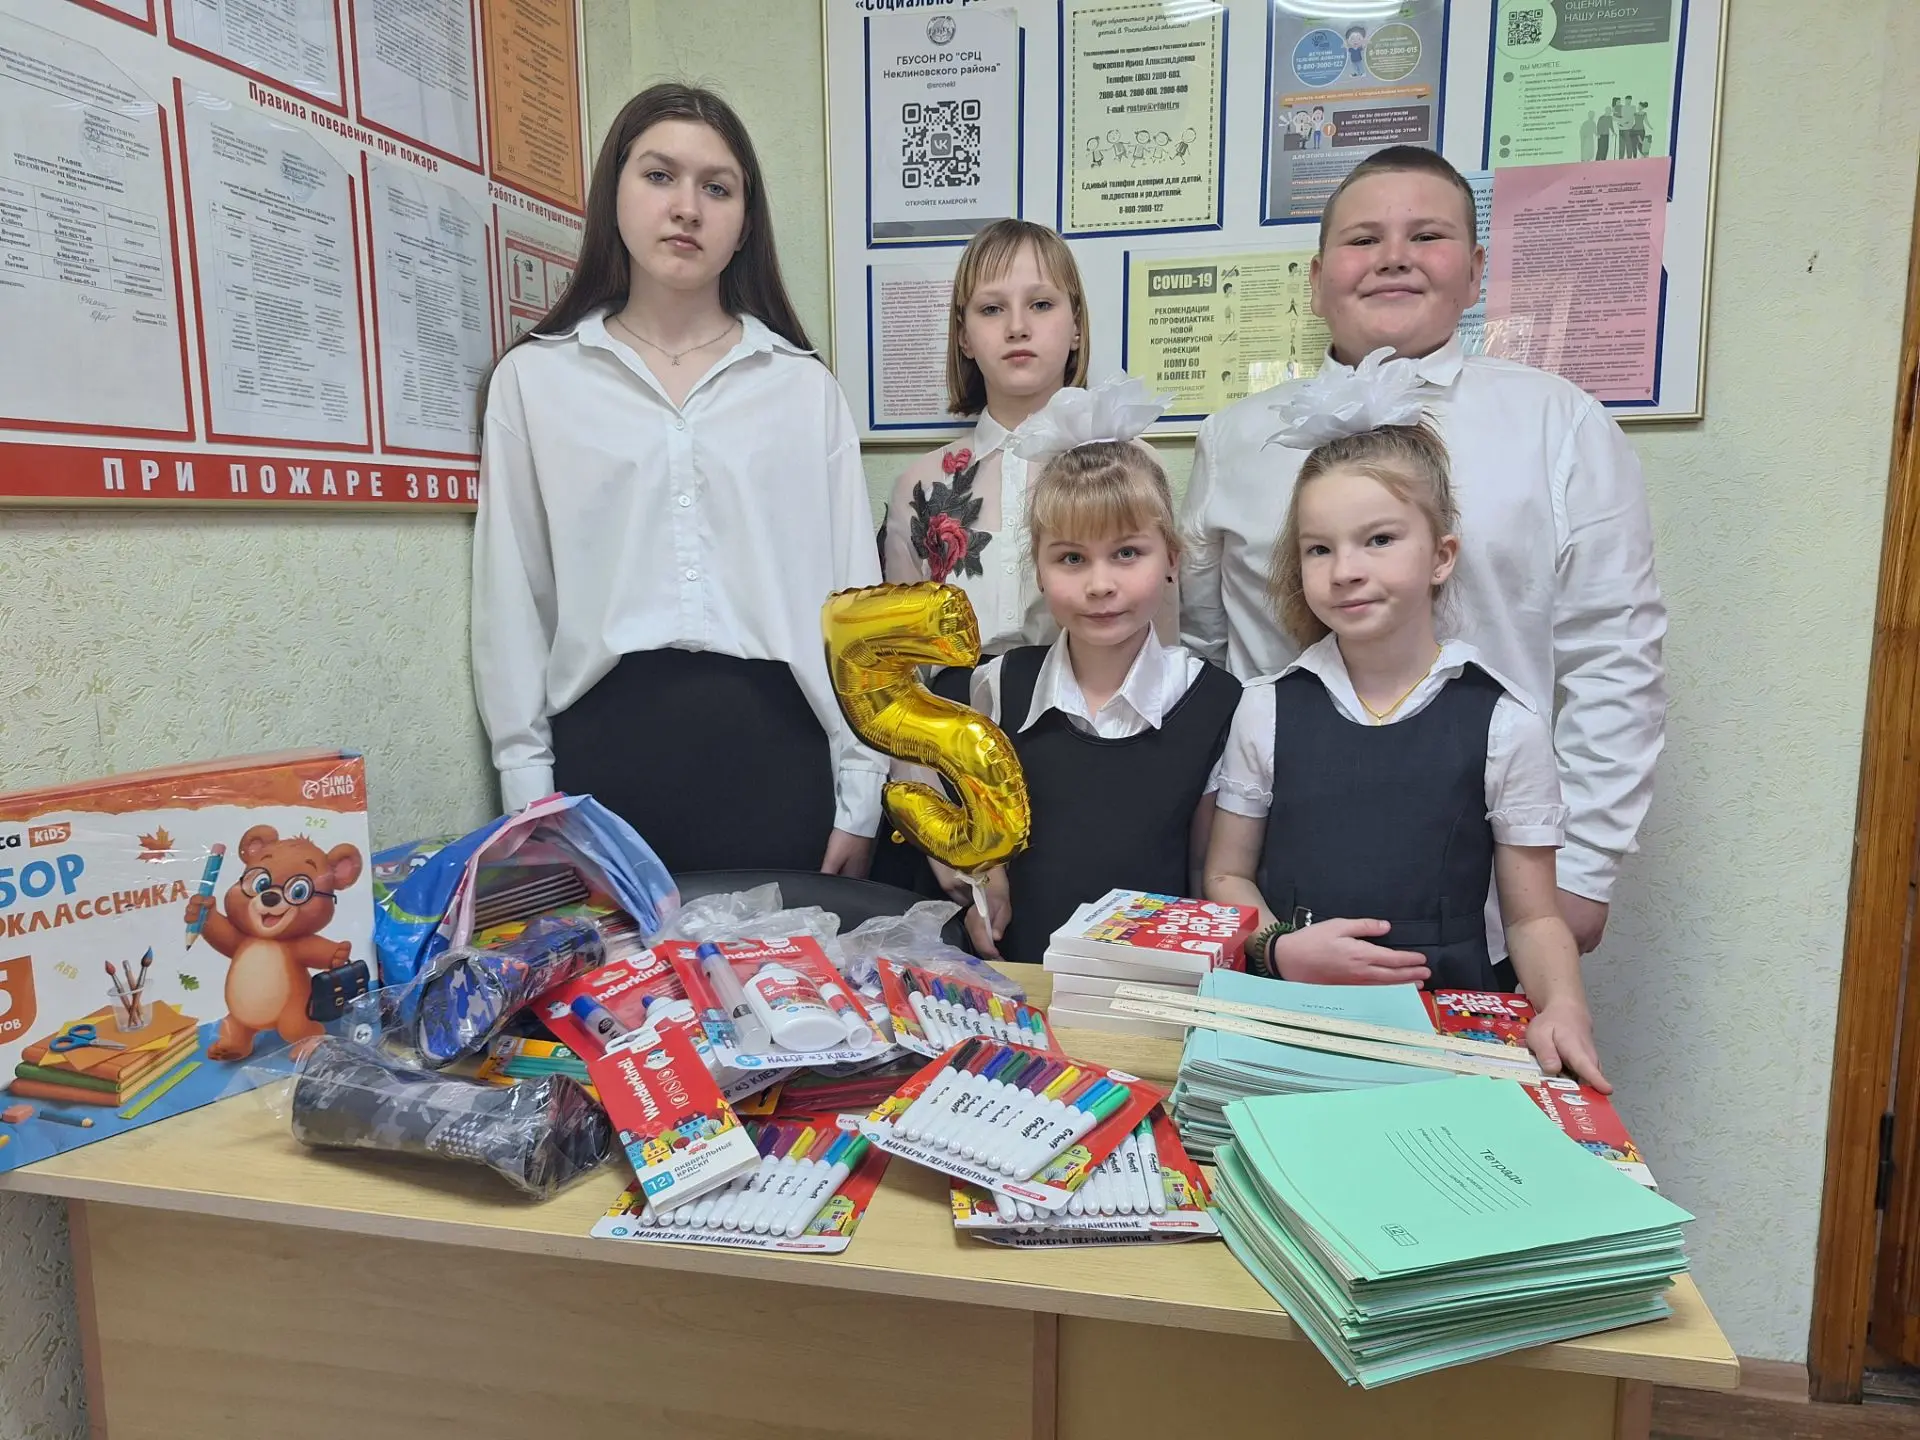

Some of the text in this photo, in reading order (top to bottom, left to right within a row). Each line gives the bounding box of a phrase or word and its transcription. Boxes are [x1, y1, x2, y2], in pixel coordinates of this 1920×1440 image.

[1564, 8, 1638, 22] НАШУ РАБОТУ
[896, 52, 981, 65] ГБУСОН РО "СРЦ
[883, 63, 1001, 79] Неклиновского района"
[249, 81, 438, 173] Правила поведения при пожаре
[488, 182, 517, 206] Работа
[519, 198, 525, 209] с
[1152, 272, 1213, 290] COVID-19
[1154, 305, 1210, 315] РЕКОМЕНДАЦИИ
[1149, 315, 1215, 325] ПО ПРОФИЛАКТИКЕ
[1170, 325, 1193, 334] НОВОЙ
[1150, 334, 1213, 345] КОРОНАВИРУСНОЙ
[1162, 346, 1200, 354] ИНФЕКЦИИ
[1164, 359, 1187, 368] КОМУ
[1163, 371, 1190, 380] БОЛЕЕ
[1191, 370, 1206, 379] ЛЕТ
[103, 457, 478, 500] ПРИ ПОЖАРЕ ЗВОН
[322, 775, 353, 787] SIMA
[322, 784, 354, 798] LAND
[767, 1054, 803, 1063] НАБОР
[676, 1159, 709, 1179] КРАСКИ
[882, 1139, 998, 1185] МАРКЕРЫ ПЕРМАНЕНТНЫЕ
[1479, 1148, 1523, 1186] Тетрадь
[647, 1176, 666, 1190] 12
[1390, 1225, 1405, 1235] 12
[633, 1229, 686, 1242] МАРКЕРЫ
[687, 1233, 769, 1247] ПЕРМАНЕНТНЫЕ
